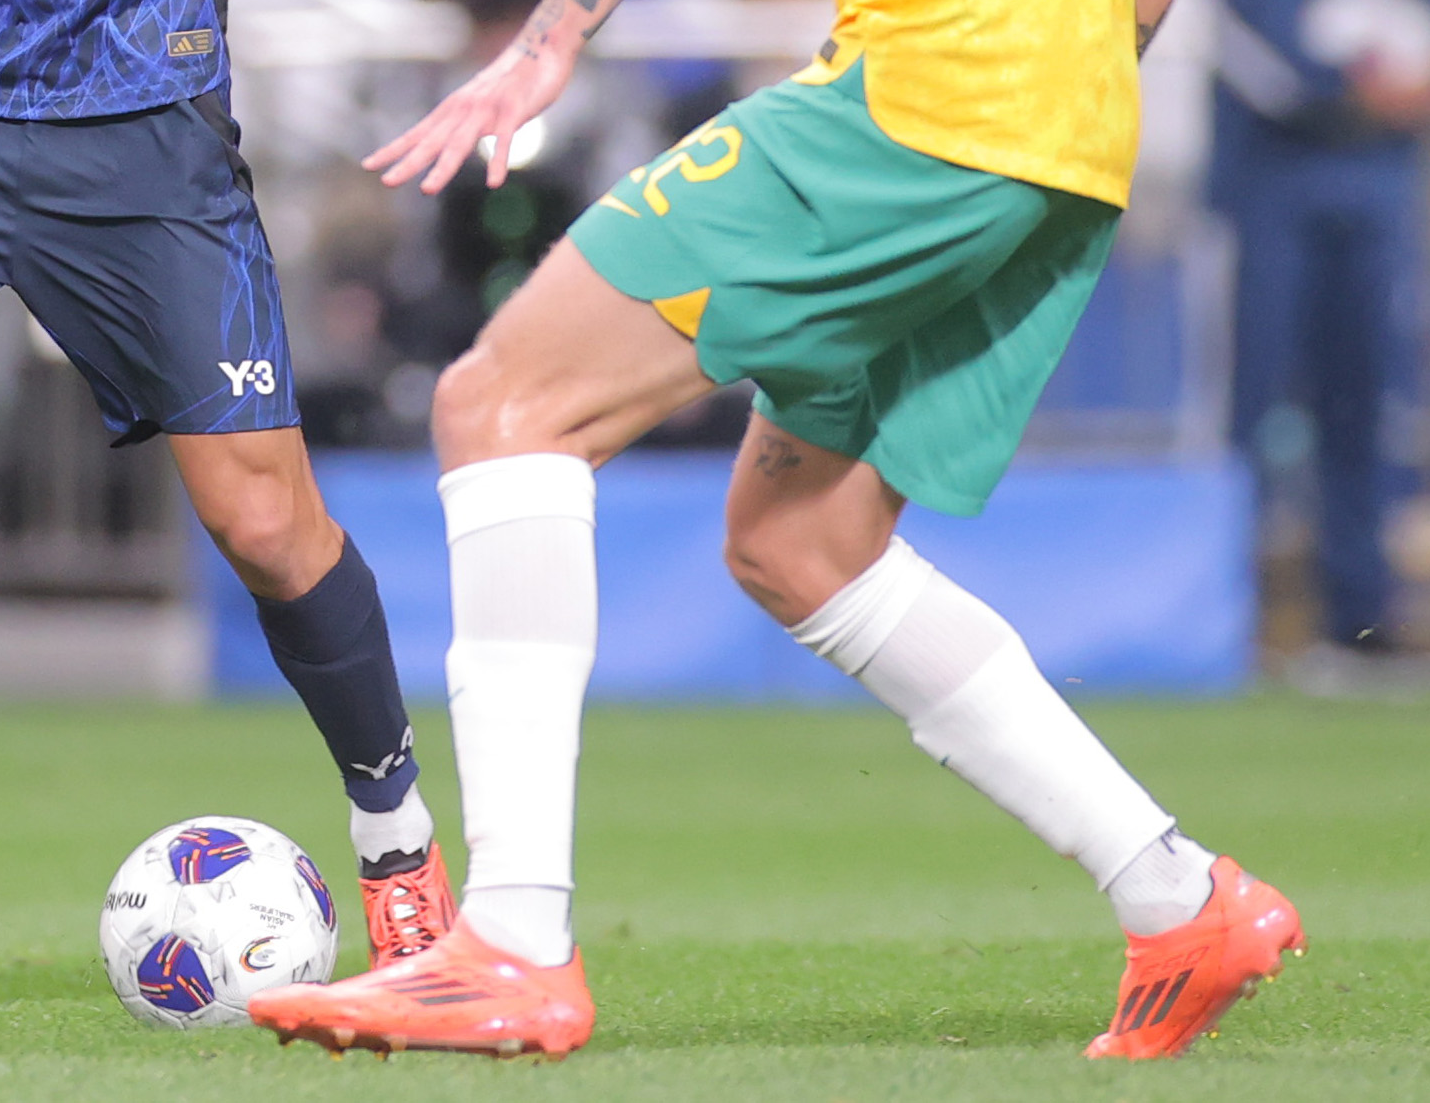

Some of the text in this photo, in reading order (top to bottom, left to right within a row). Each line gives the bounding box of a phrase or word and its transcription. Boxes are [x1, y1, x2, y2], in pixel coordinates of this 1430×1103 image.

[218, 360, 275, 396] Y-3
[104, 891, 148, 912] molte
[260, 913, 284, 926] ASIAN
